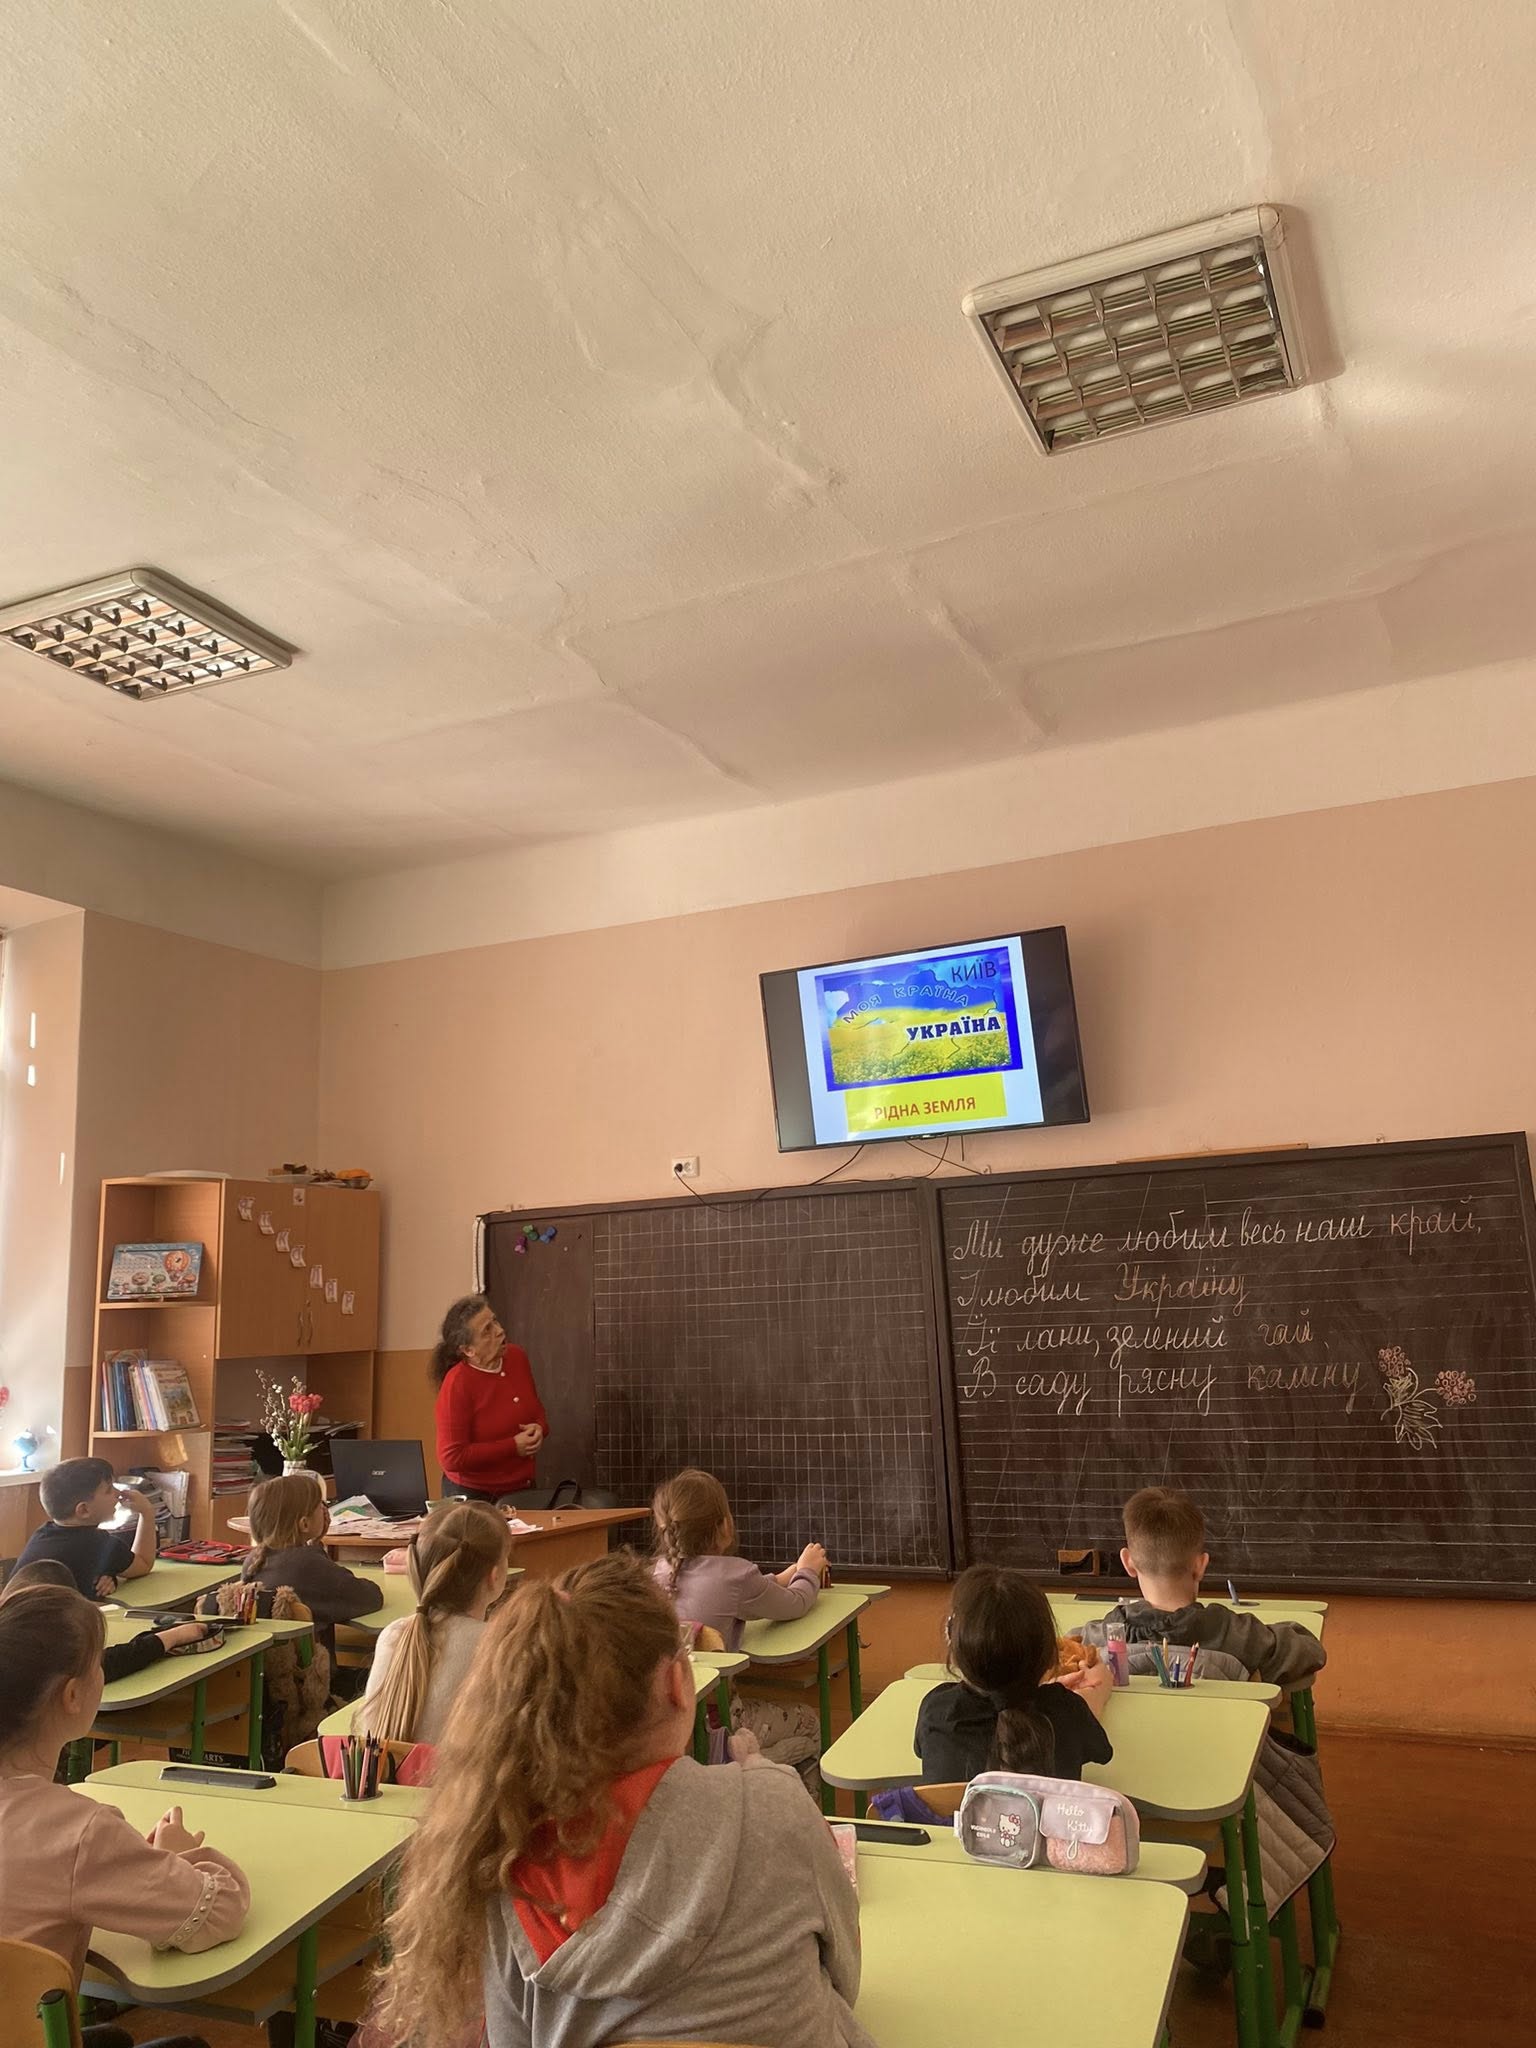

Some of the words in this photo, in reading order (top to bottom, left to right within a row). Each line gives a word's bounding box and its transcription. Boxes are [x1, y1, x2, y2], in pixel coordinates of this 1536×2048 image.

[951, 959, 998, 983] КИЇВ
[842, 994, 882, 1024] МОЯ
[893, 984, 969, 1007] КРАЇНА
[906, 1015, 1001, 1041] УКРАЇНА
[874, 1101, 921, 1121] РІДНА
[923, 1096, 977, 1115] ЗЕМЛЯ
[953, 1219, 1004, 1260] Ми
[1021, 1232, 1105, 1276] дуже
[1117, 1209, 1233, 1252] любим
[1240, 1206, 1286, 1247] весь
[1295, 1214, 1374, 1243] наш
[1390, 1194, 1482, 1256] край,
[980, 1274, 1092, 1307] любим
[1114, 1262, 1250, 1319] Україну
[1106, 1315, 1228, 1370] зелений
[963, 1355, 997, 1399] В
[1015, 1370, 1093, 1416] саду
[1117, 1364, 1218, 1418] рясну
[1248, 1362, 1368, 1415] калину
[1056, 1802, 1085, 1816] Hello
[1067, 1819, 1093, 1837] Kitty
